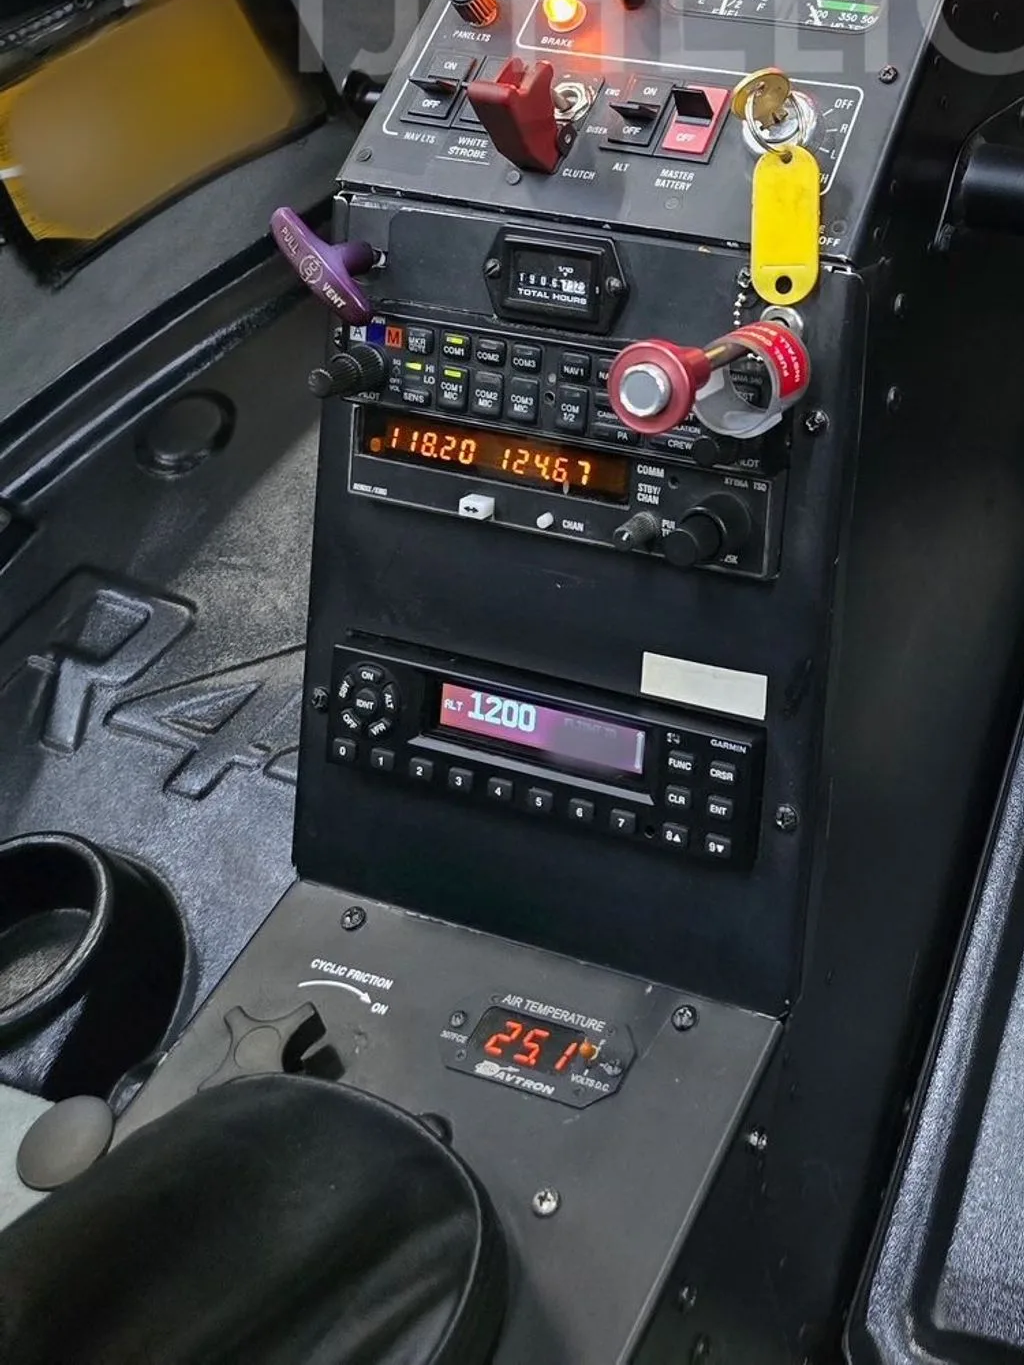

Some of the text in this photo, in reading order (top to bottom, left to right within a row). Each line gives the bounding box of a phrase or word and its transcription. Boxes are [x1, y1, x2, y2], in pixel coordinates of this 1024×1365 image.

[452, 30, 477, 42] PANEL
[540, 36, 575, 48] BRAKE
[444, 61, 457, 71] ON
[643, 86, 658, 96] ON
[422, 99, 440, 109] OFF
[834, 98, 854, 110] OFF
[622, 126, 641, 135] OFF
[404, 131, 422, 143] NAV
[457, 136, 489, 148] WHITE
[448, 146, 488, 159] STROBE
[612, 161, 630, 172] ALT
[562, 167, 596, 180] CLUTCH
[660, 168, 694, 181] MASTER
[654, 178, 692, 191] BATTERY
[280, 227, 300, 254] PULL
[321, 282, 347, 309] VENT
[517, 287, 588, 305] TOTAL HOURS
[443, 346, 465, 357] COM1
[476, 351, 500, 362] COM2
[512, 357, 536, 368] COM3
[440, 381, 463, 393] COM1
[475, 389, 498, 400] COM2
[510, 394, 534, 406] COM3
[560, 403, 580, 414] COM
[667, 439, 693, 451] CREW
[391, 427, 591, 485] 118.20 124.67
[637, 464, 665, 478] COMM
[637, 483, 661, 496] STBY/
[637, 494, 659, 505] CHAN
[562, 519, 584, 532] CHAN
[361, 670, 375, 681] ON
[356, 698, 375, 711] IDNT
[444, 697, 464, 712] ALT
[467, 690, 537, 733] 1200
[342, 713, 358, 729] OFF
[370, 721, 387, 736] VFR
[710, 738, 747, 754] GARMIN
[668, 757, 692, 771] FUNC
[709, 767, 734, 782] CRSR
[667, 793, 686, 805] CLR
[709, 804, 728, 816] ENT
[311, 957, 393, 991] CYCLIC FRICTION
[370, 1001, 388, 1016] ON
[502, 993, 606, 1033] AIR TEMPERATURE
